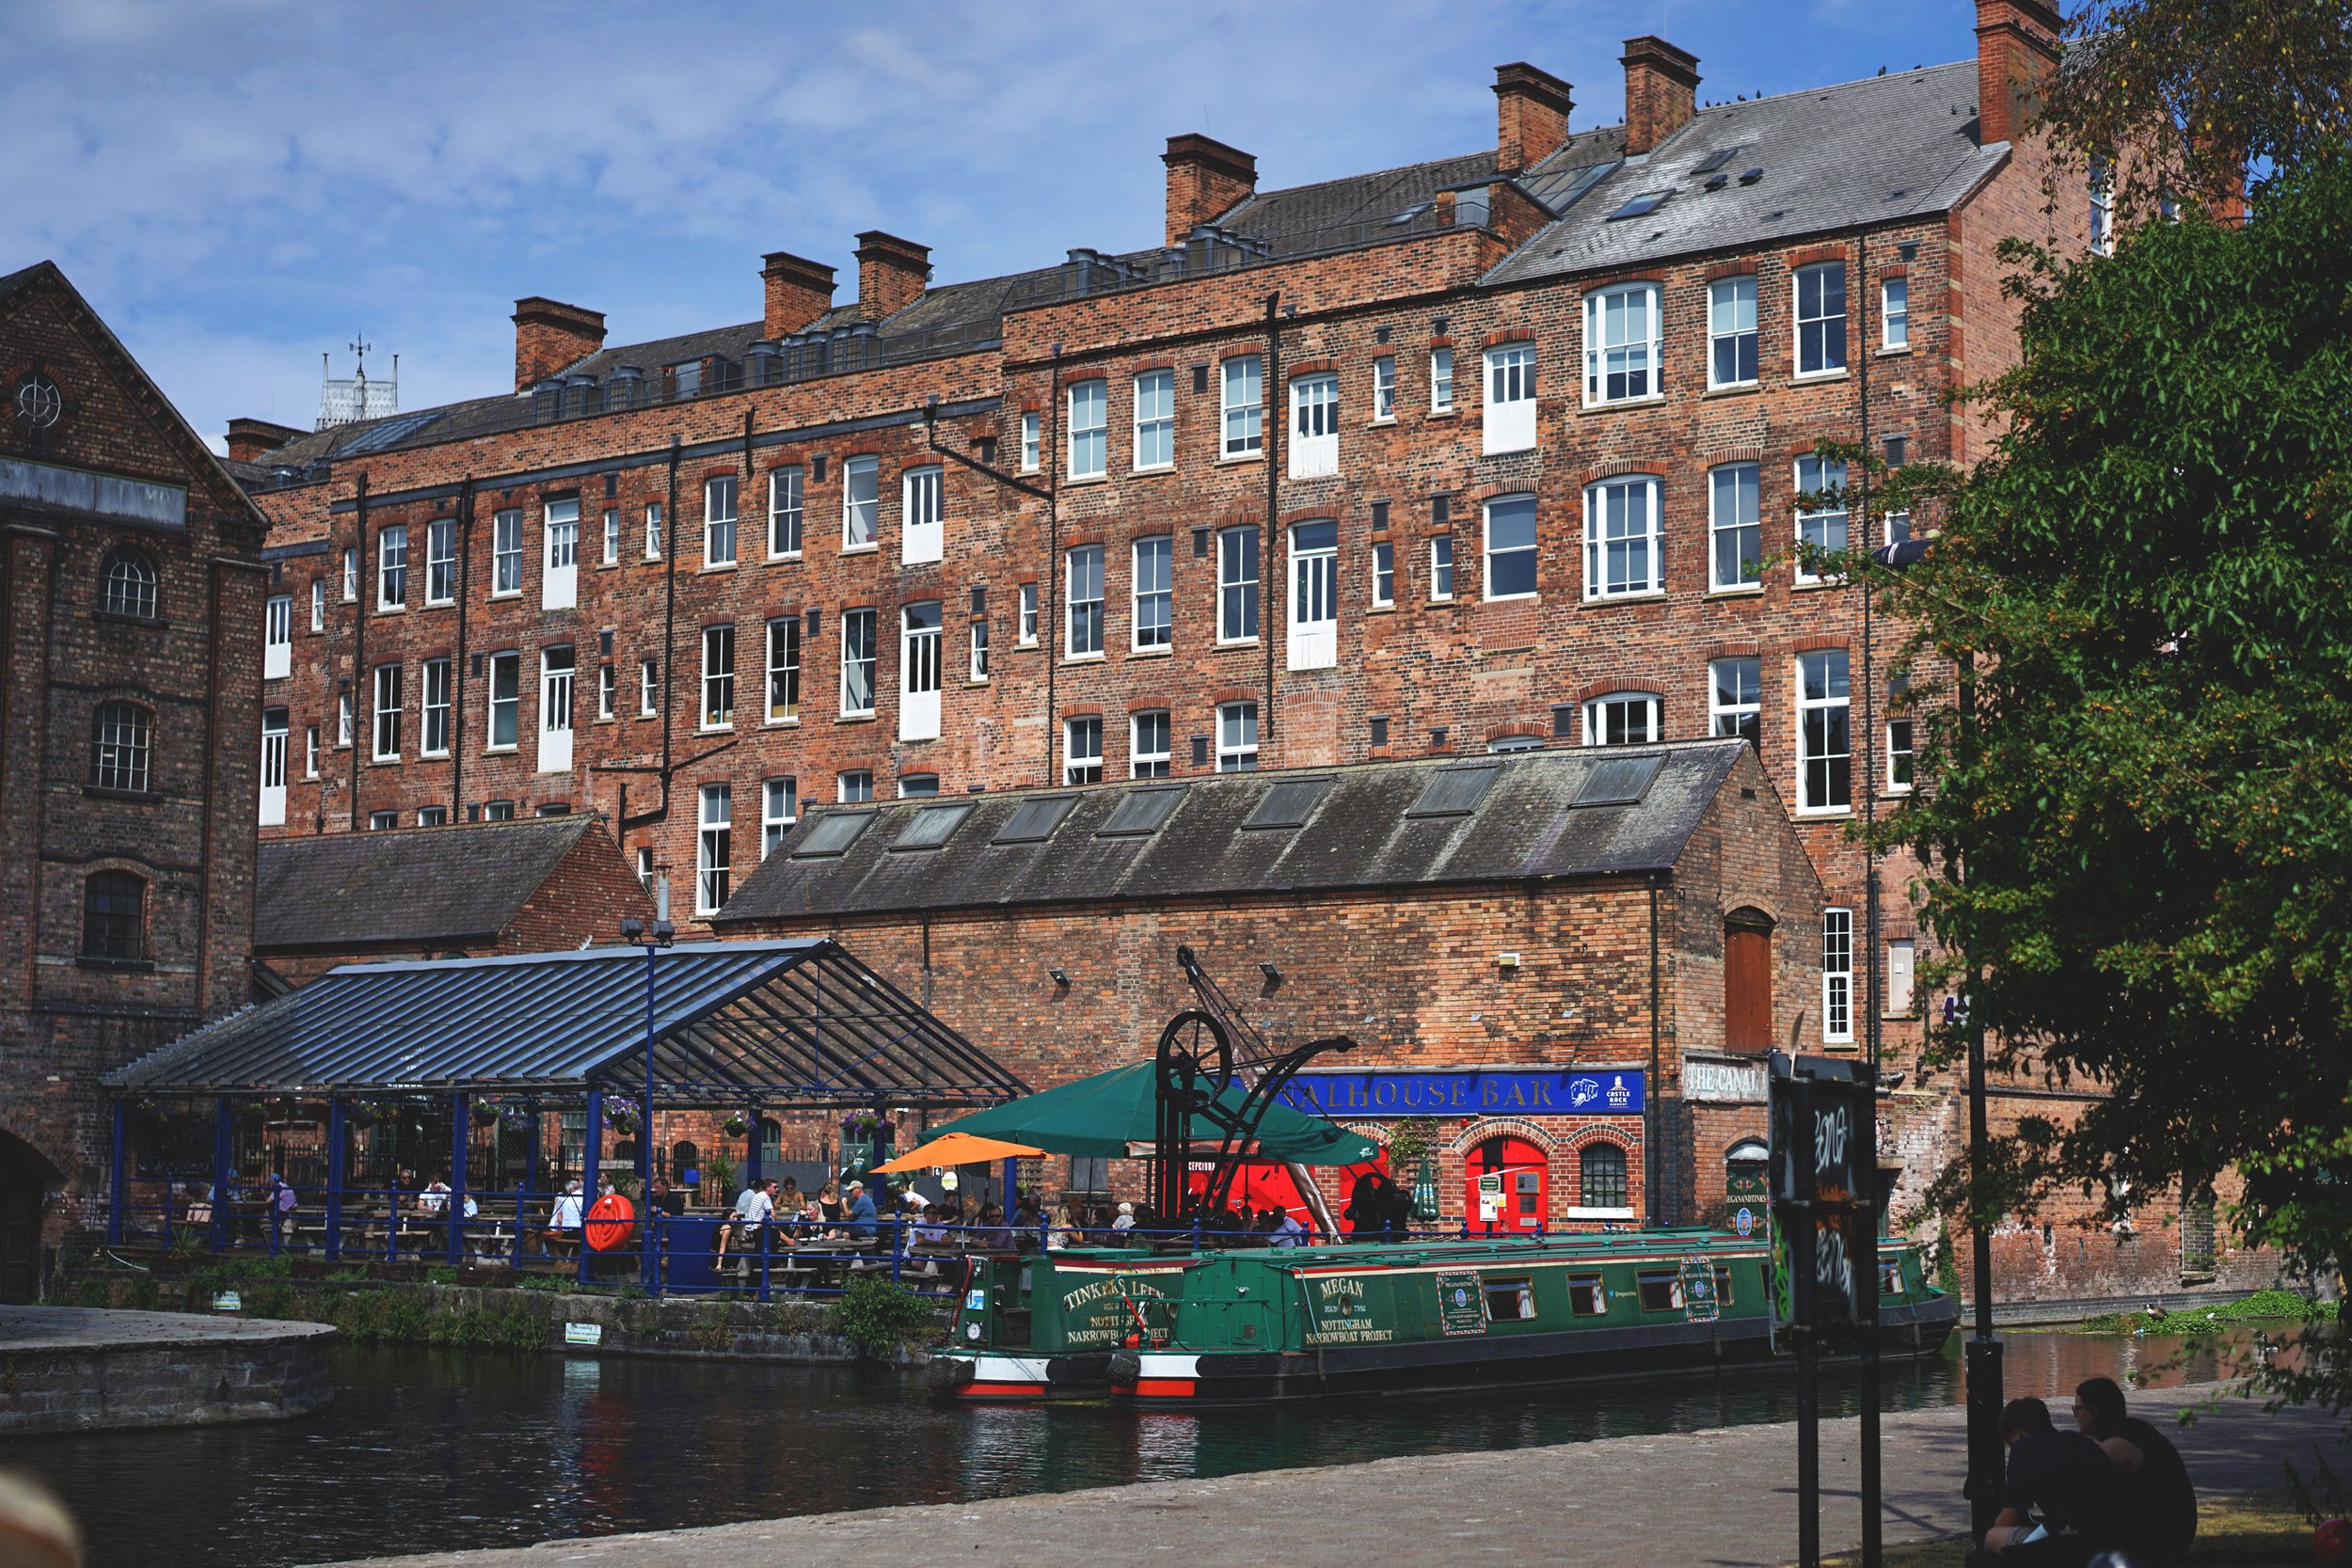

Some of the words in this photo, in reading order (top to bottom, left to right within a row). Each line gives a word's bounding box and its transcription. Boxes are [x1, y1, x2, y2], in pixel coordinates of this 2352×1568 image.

[1687, 1067, 1715, 1091] THE
[1717, 1068, 1758, 1092] CANAL
[1276, 1081, 1468, 1107] NALHOUSE
[1482, 1080, 1552, 1106] BAR
[1726, 1195, 1767, 1204] EGANANDTINKS
[1320, 1278, 1364, 1299] MEGAN
[1321, 1319, 1373, 1331] NOTTINGHAM
[1306, 1331, 1359, 1344] NARROWBOAT
[1360, 1329, 1392, 1341] PROJECT
